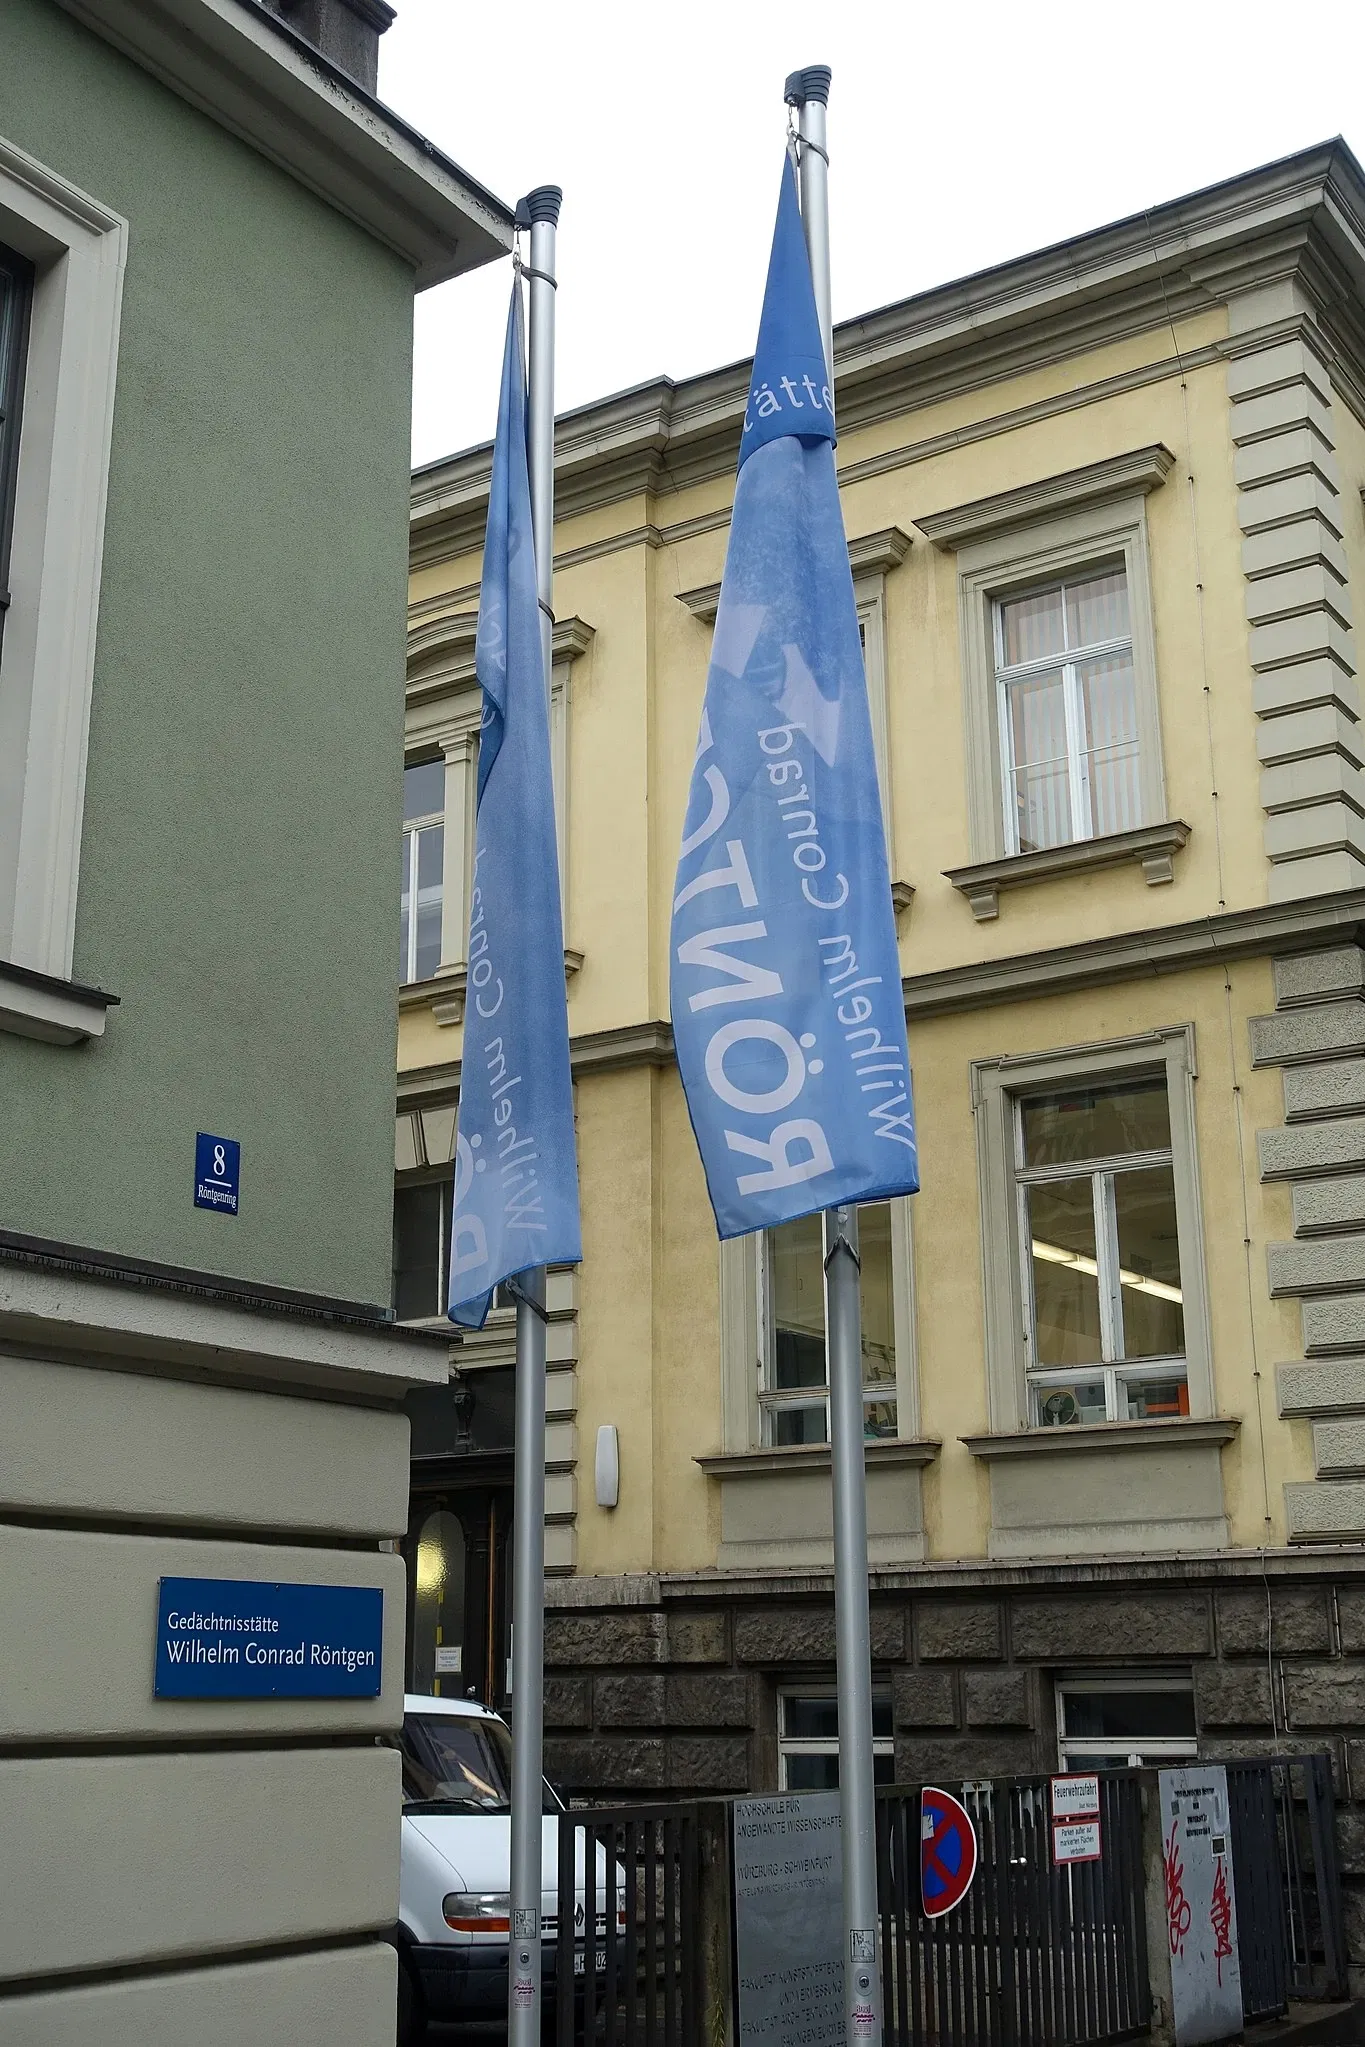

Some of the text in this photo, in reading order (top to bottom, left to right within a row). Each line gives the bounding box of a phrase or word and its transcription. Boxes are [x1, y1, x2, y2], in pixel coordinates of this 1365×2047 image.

[213, 1144, 225, 1176] 8
[198, 1184, 237, 1208] Röntgenring
[168, 1611, 279, 1633] Gedächtnisstätte
[166, 1639, 375, 1673] Wilhelm Conrad Röntgen
[1054, 1783, 1097, 1798] Feuerwehrzufahrt
[737, 1801, 785, 1817] HOCHSCHULE
